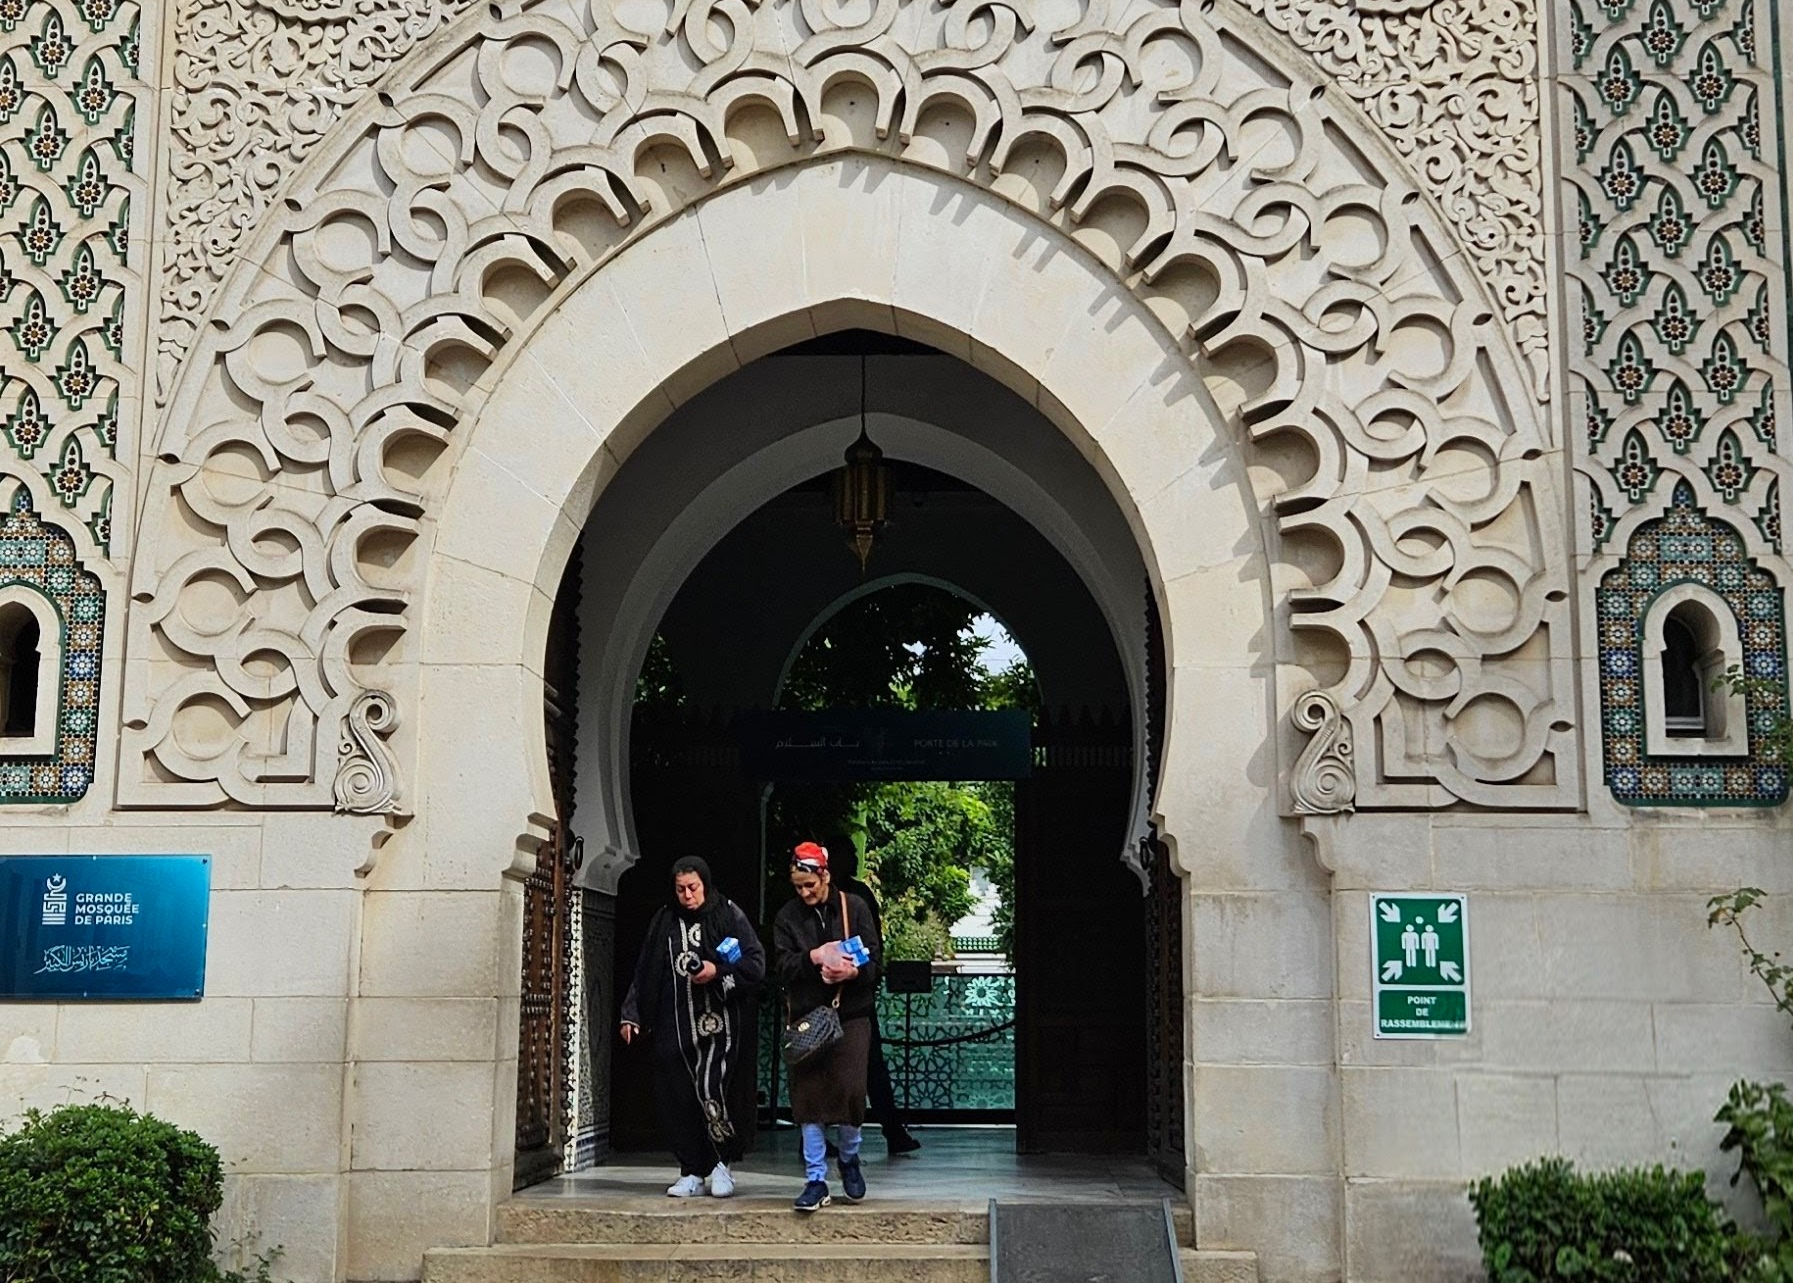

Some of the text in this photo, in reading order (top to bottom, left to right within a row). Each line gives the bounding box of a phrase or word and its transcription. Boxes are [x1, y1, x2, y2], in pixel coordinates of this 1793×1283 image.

[962, 739, 975, 749] LA
[75, 892, 132, 903] GRANDE
[75, 902, 140, 915] MOSQUÉE
[74, 915, 133, 925] DE PARIS
[1407, 996, 1437, 1005] POINT
[1415, 1008, 1429, 1017] DE
[1380, 1019, 1466, 1029] RASSEMBLEME
